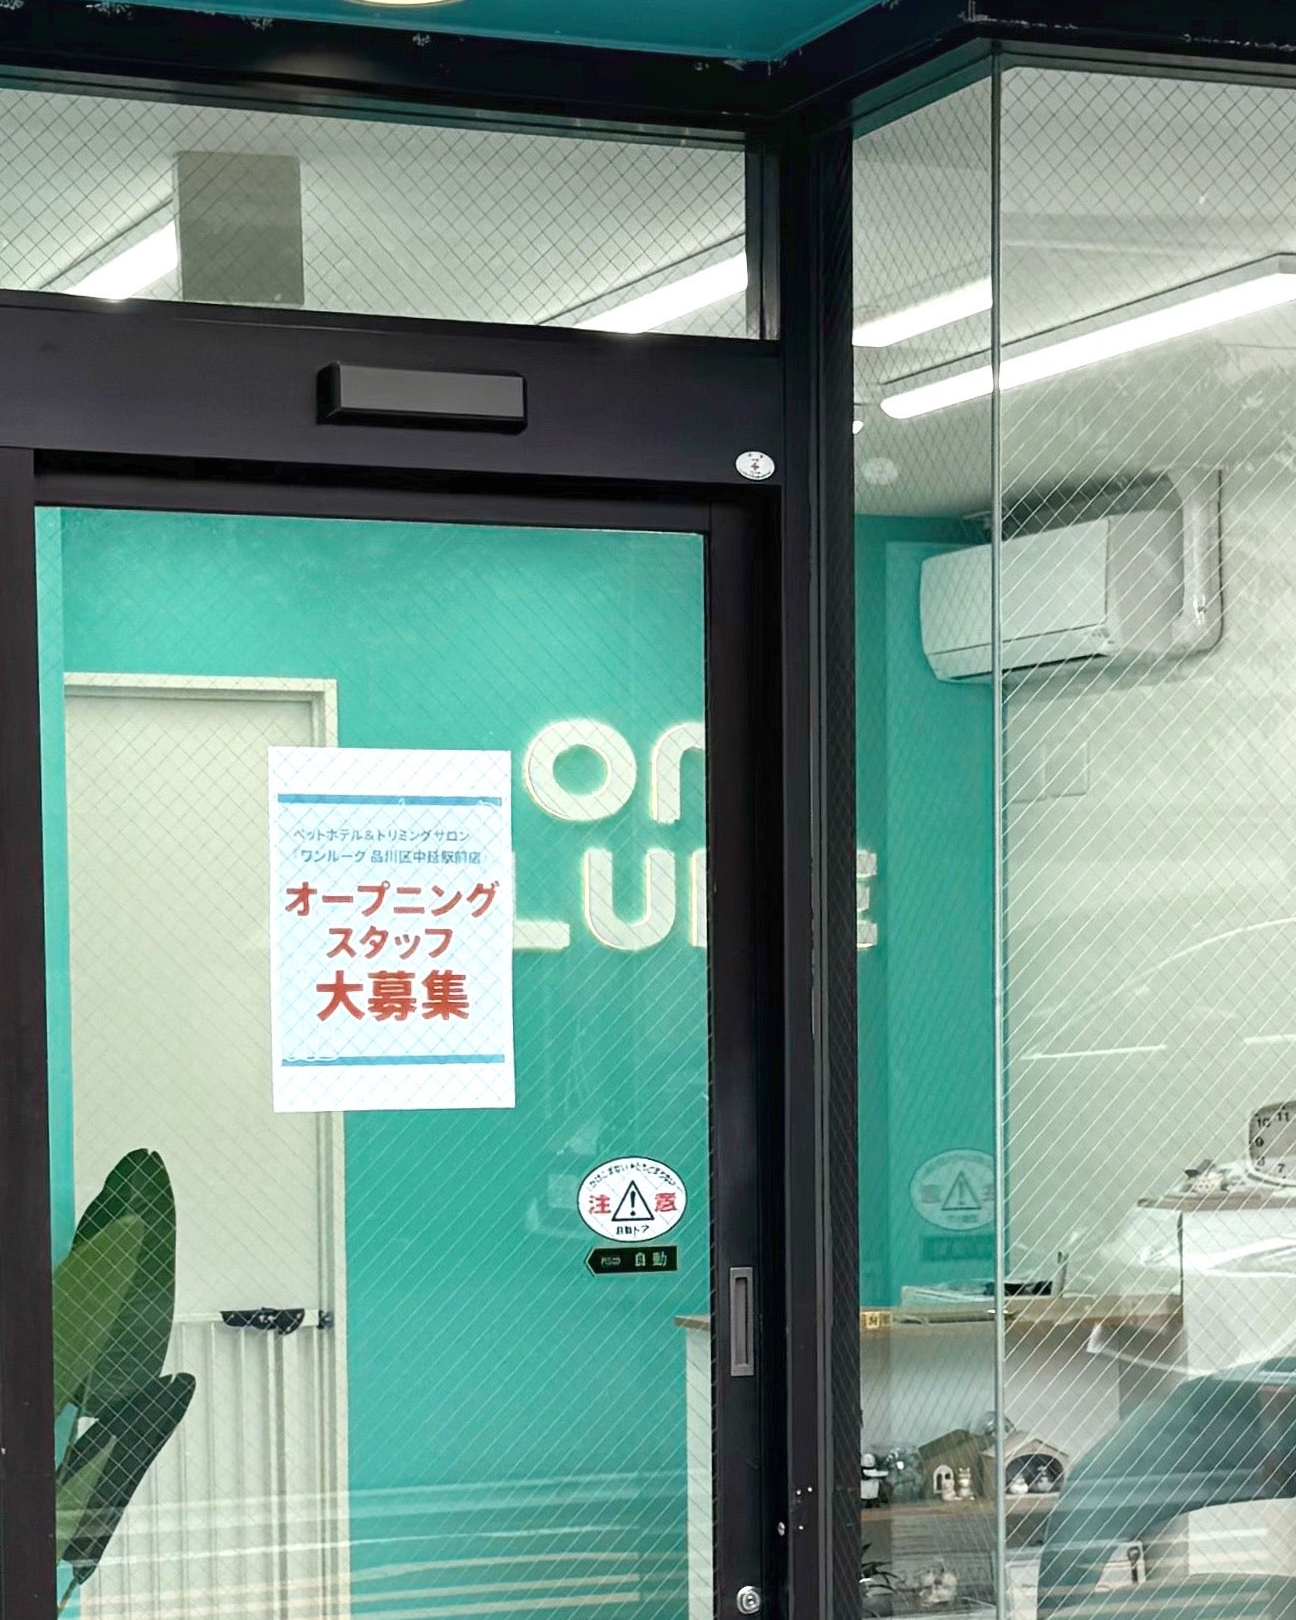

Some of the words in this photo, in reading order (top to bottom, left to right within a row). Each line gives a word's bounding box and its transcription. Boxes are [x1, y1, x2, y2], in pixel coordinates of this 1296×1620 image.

[285, 880, 500, 918] オープニング
[326, 925, 453, 960] スタッフ
[316, 970, 470, 1021] 大募集
